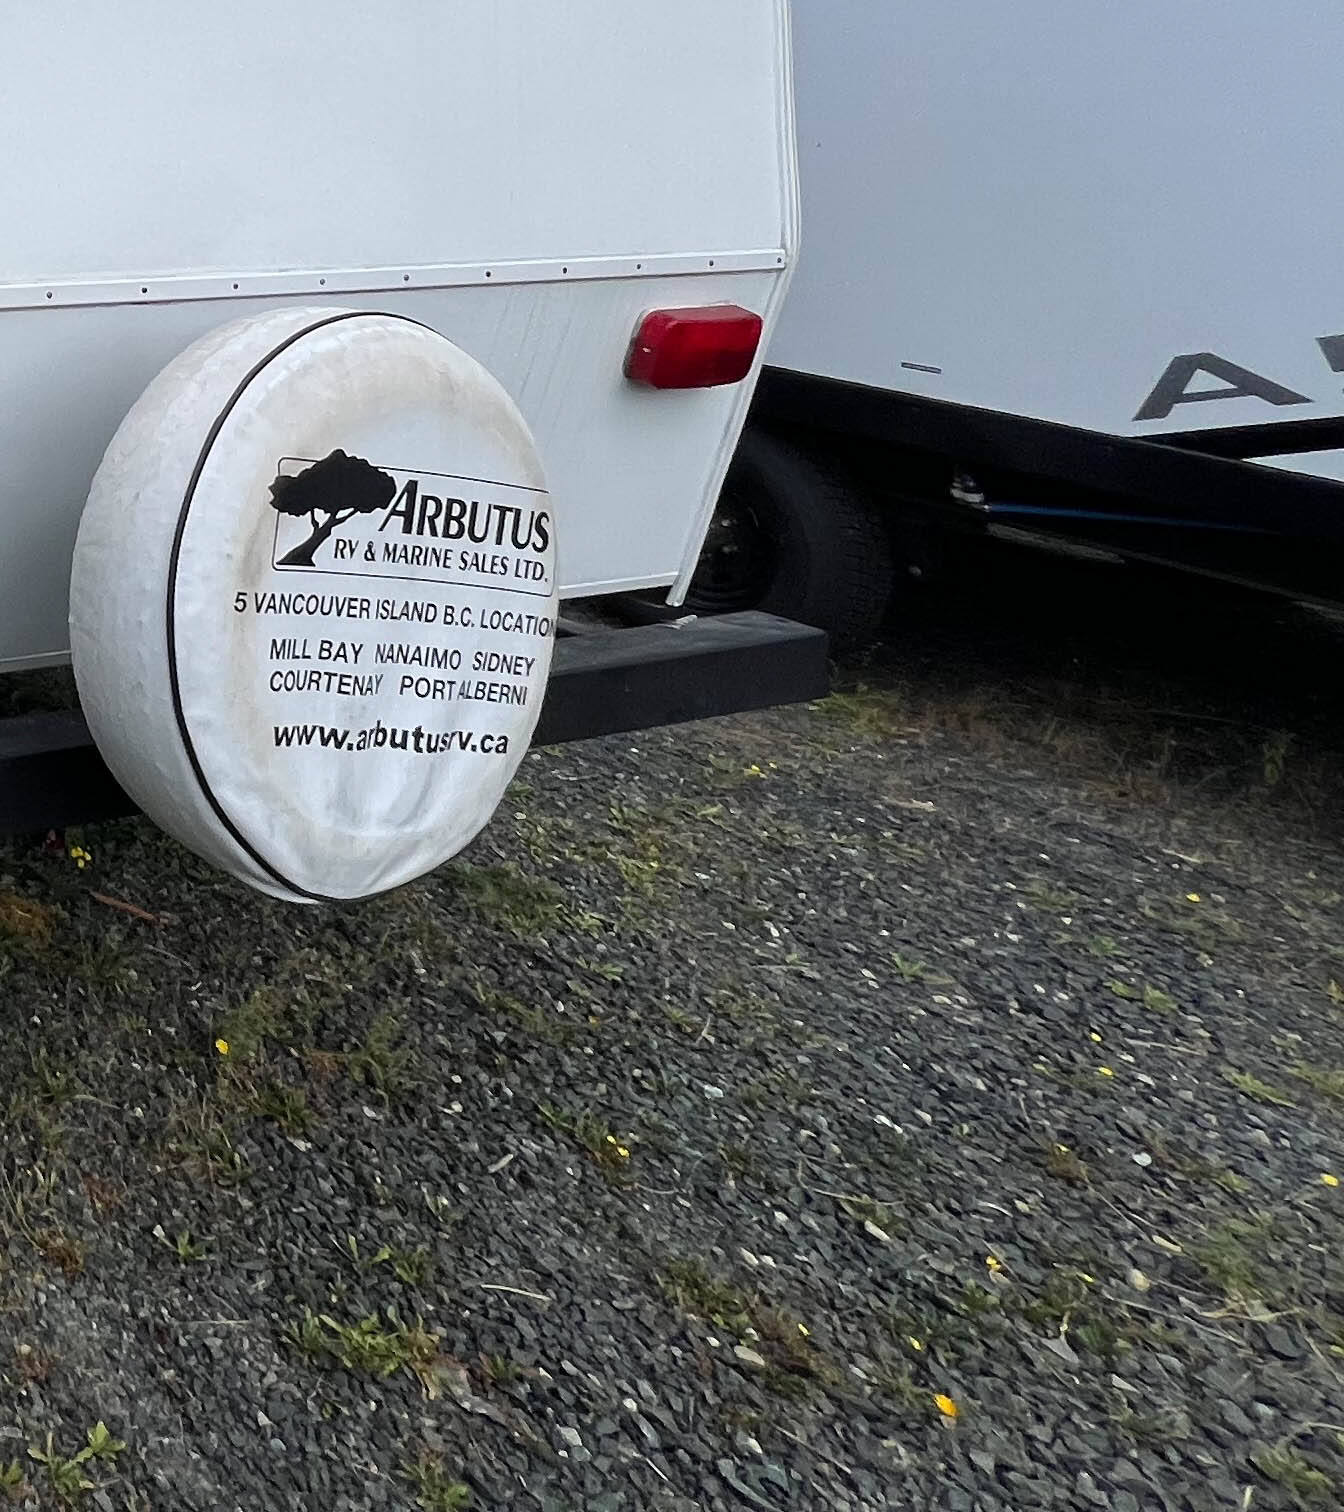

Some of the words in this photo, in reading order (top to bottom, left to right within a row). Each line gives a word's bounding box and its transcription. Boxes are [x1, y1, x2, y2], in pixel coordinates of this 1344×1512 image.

[378, 479, 550, 553] ARBUTUS
[333, 538, 357, 561] RV
[363, 541, 377, 563] &
[382, 542, 453, 570] MARINE
[458, 550, 510, 577] SALES
[514, 558, 548, 583] LTD.
[233, 592, 248, 614] 5
[254, 591, 370, 619] VANCOUVER
[375, 599, 437, 624] ISLAND
[443, 604, 475, 628] B.C.
[269, 638, 312, 661] MILL
[317, 640, 364, 664] BAY
[374, 643, 462, 670] NANAIMO
[472, 650, 536, 677] SIDNEY
[269, 670, 384, 696] COURTENAY
[399, 675, 457, 702] PORT
[459, 679, 528, 705] ALBERNI
[273, 720, 510, 754] www.arbutusrv.ca
